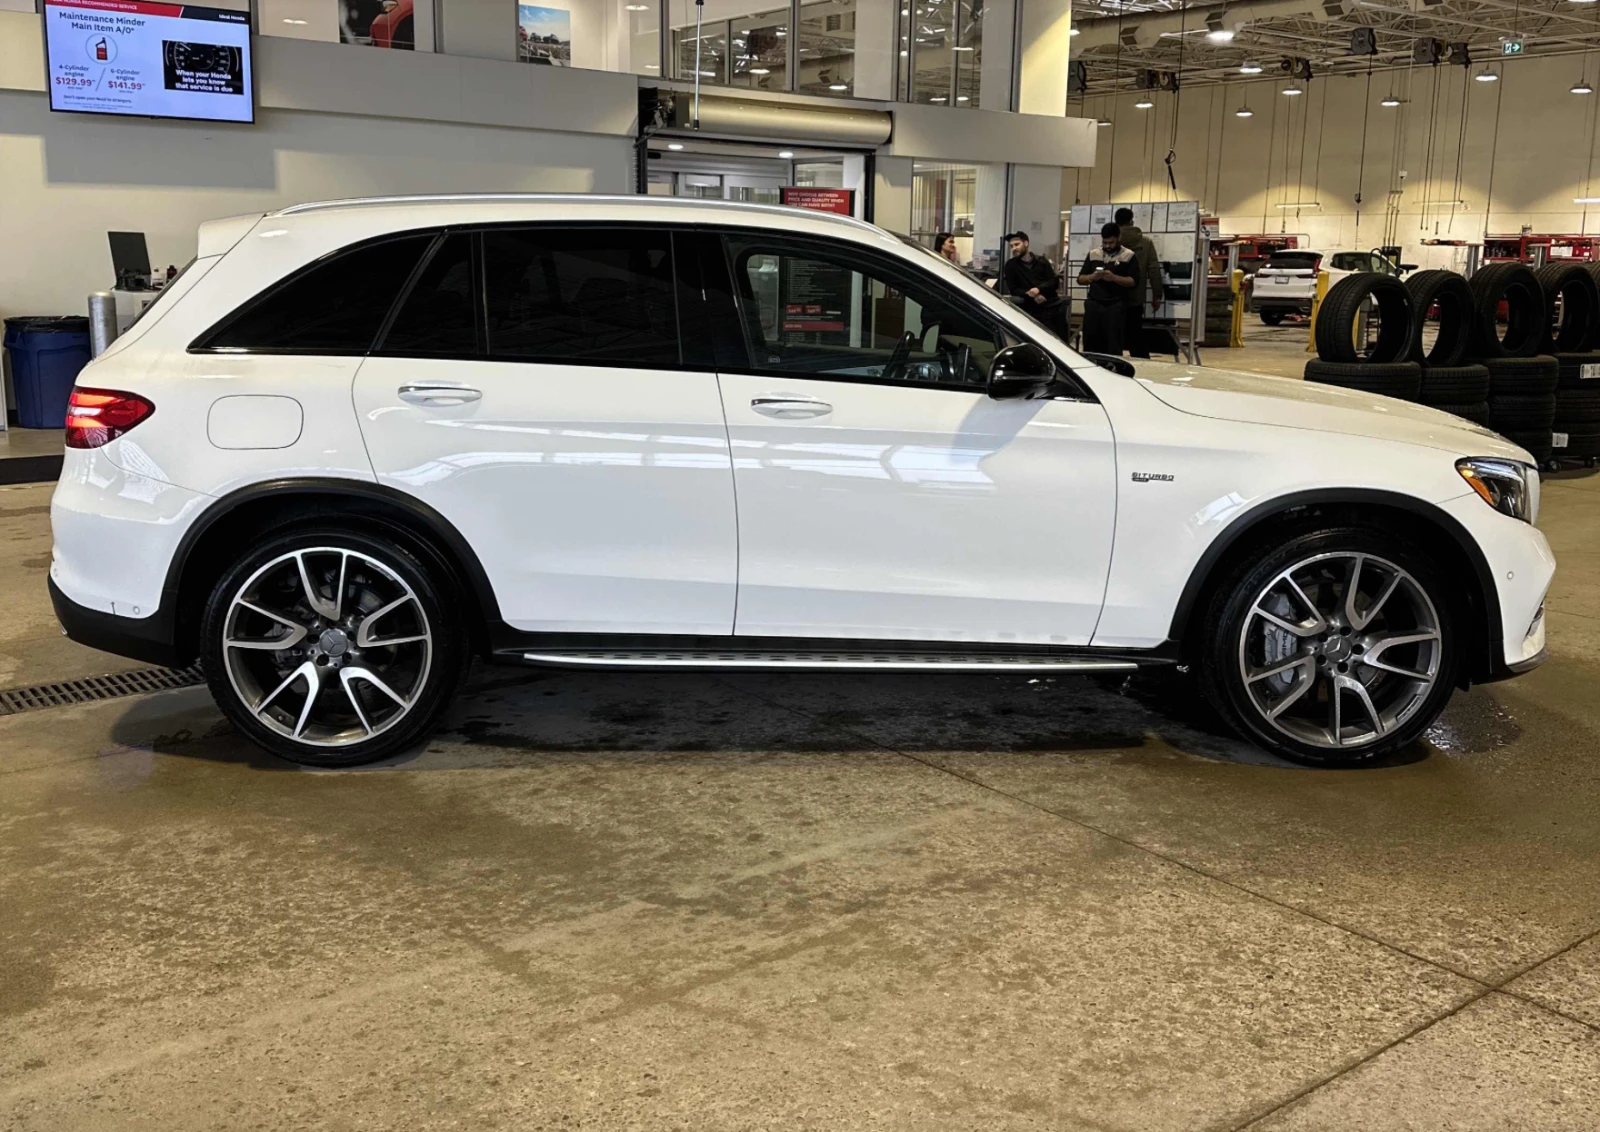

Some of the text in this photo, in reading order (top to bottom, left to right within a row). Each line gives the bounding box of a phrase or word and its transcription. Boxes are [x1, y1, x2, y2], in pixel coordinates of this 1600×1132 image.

[59, 12, 146, 26] Maintenance Minder
[71, 22, 92, 30] Main
[94, 24, 113, 32] Item
[59, 64, 89, 72] 4-Cylinder
[1131, 471, 1175, 481] BITURBO
